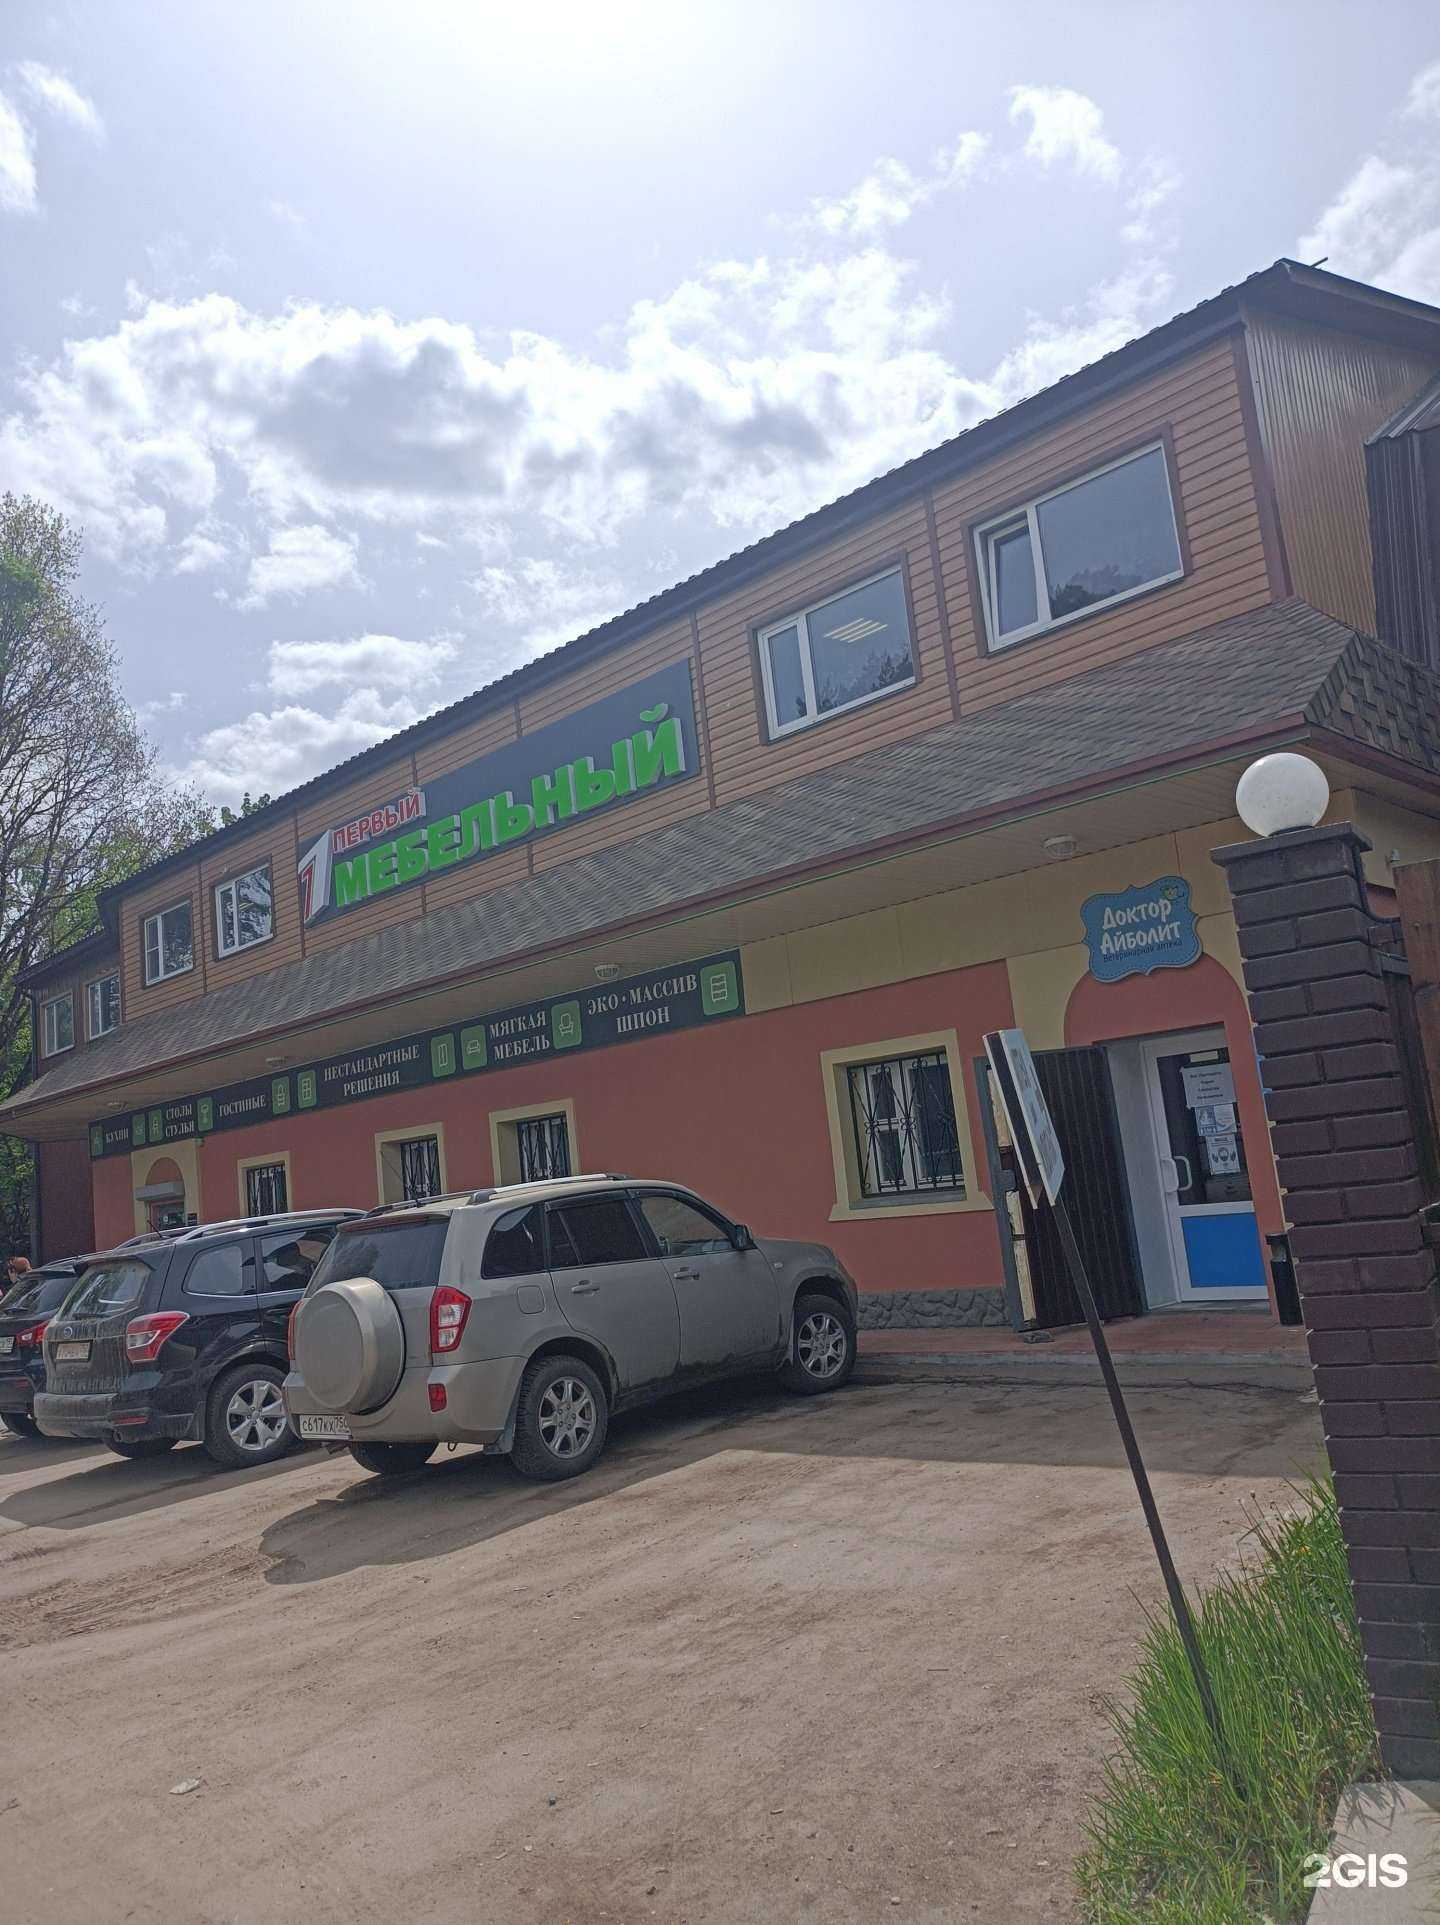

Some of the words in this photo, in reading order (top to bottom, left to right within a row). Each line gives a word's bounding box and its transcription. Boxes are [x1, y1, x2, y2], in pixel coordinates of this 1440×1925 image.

[335, 702, 686, 908] МЕБЕЛЬНЫЙ
[332, 787, 427, 853] ПЕРВЫЙ
[489, 1011, 547, 1041] МЯГКАЯ
[616, 1006, 671, 1034] ШПОН
[494, 1035, 551, 1062] МЕБЕЛЬ
[323, 1043, 421, 1083] НЕСТАНДАРТНЫЕ
[343, 1069, 401, 1097] РЕШЕНИЯ
[165, 1102, 193, 1122] СТОЛЫ
[217, 1093, 267, 1118] ГОСТИНЫЕ
[105, 1126, 129, 1144] КУХНИ
[164, 1120, 195, 1138] СТУЛЬЯ
